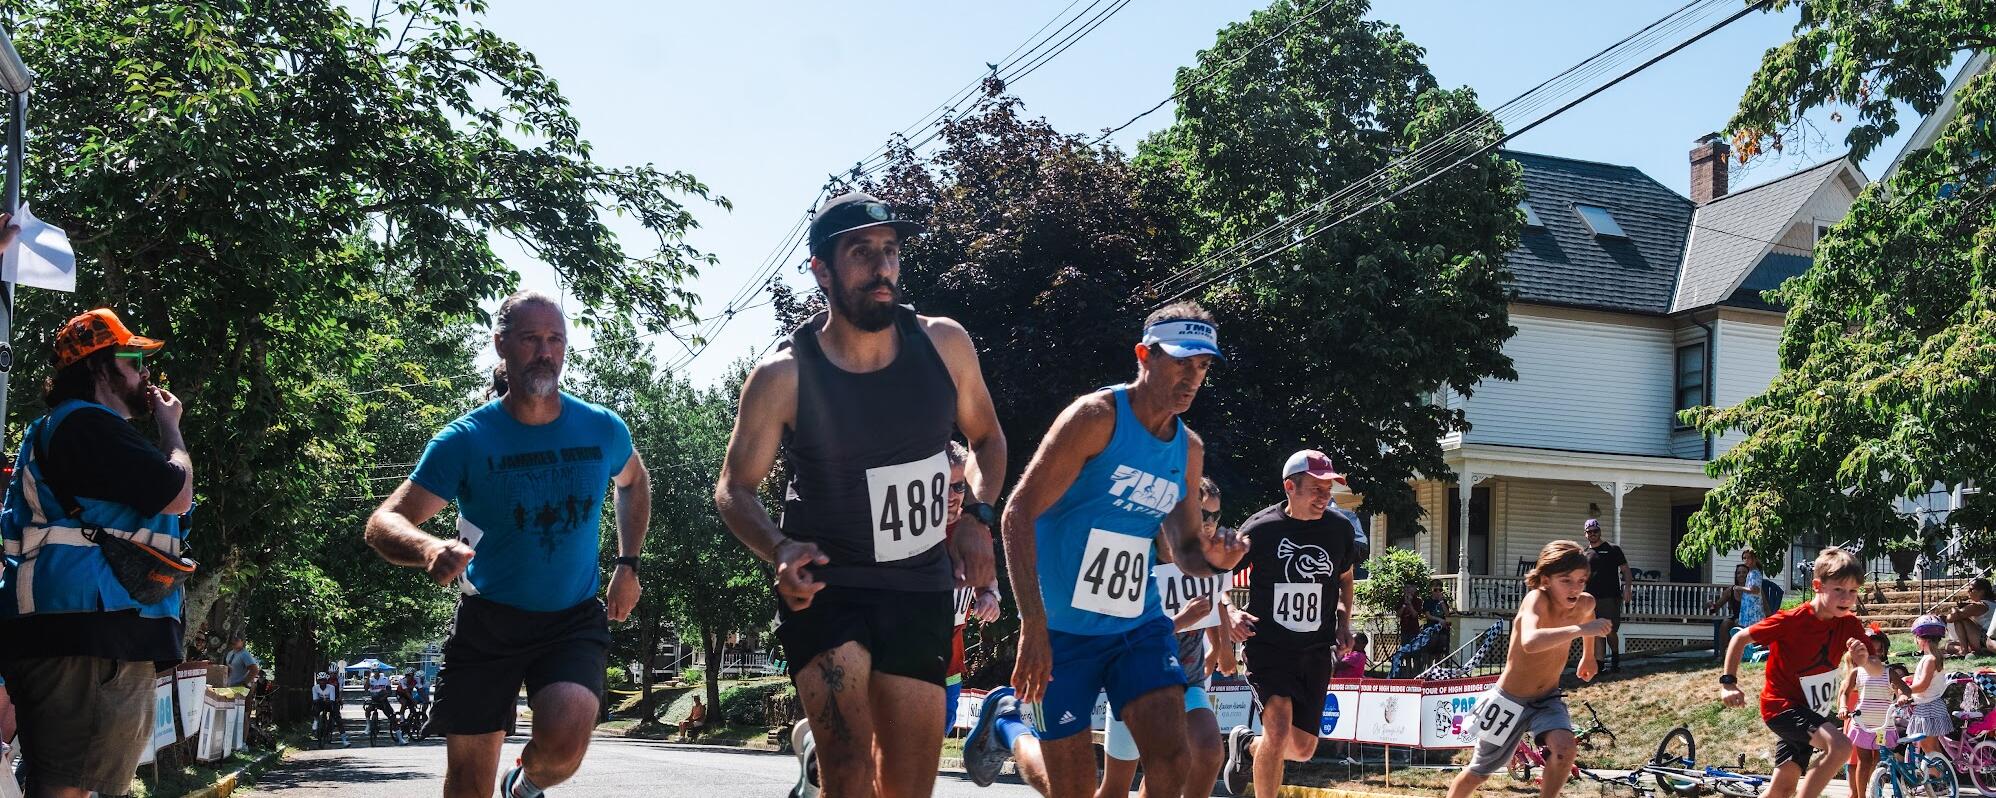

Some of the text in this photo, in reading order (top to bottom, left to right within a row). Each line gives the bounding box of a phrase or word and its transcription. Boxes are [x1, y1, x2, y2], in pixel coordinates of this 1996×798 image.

[1185, 323, 1212, 334] TMB
[879, 472, 945, 542] 488
[1083, 547, 1144, 602] 489
[1276, 592, 1318, 622] 498
[1390, 685, 1405, 693] BRIDGE
[1422, 687, 1438, 695] TOUR
[1448, 685, 1463, 693] HIGH
[1463, 683, 1483, 692] BRIDGE
